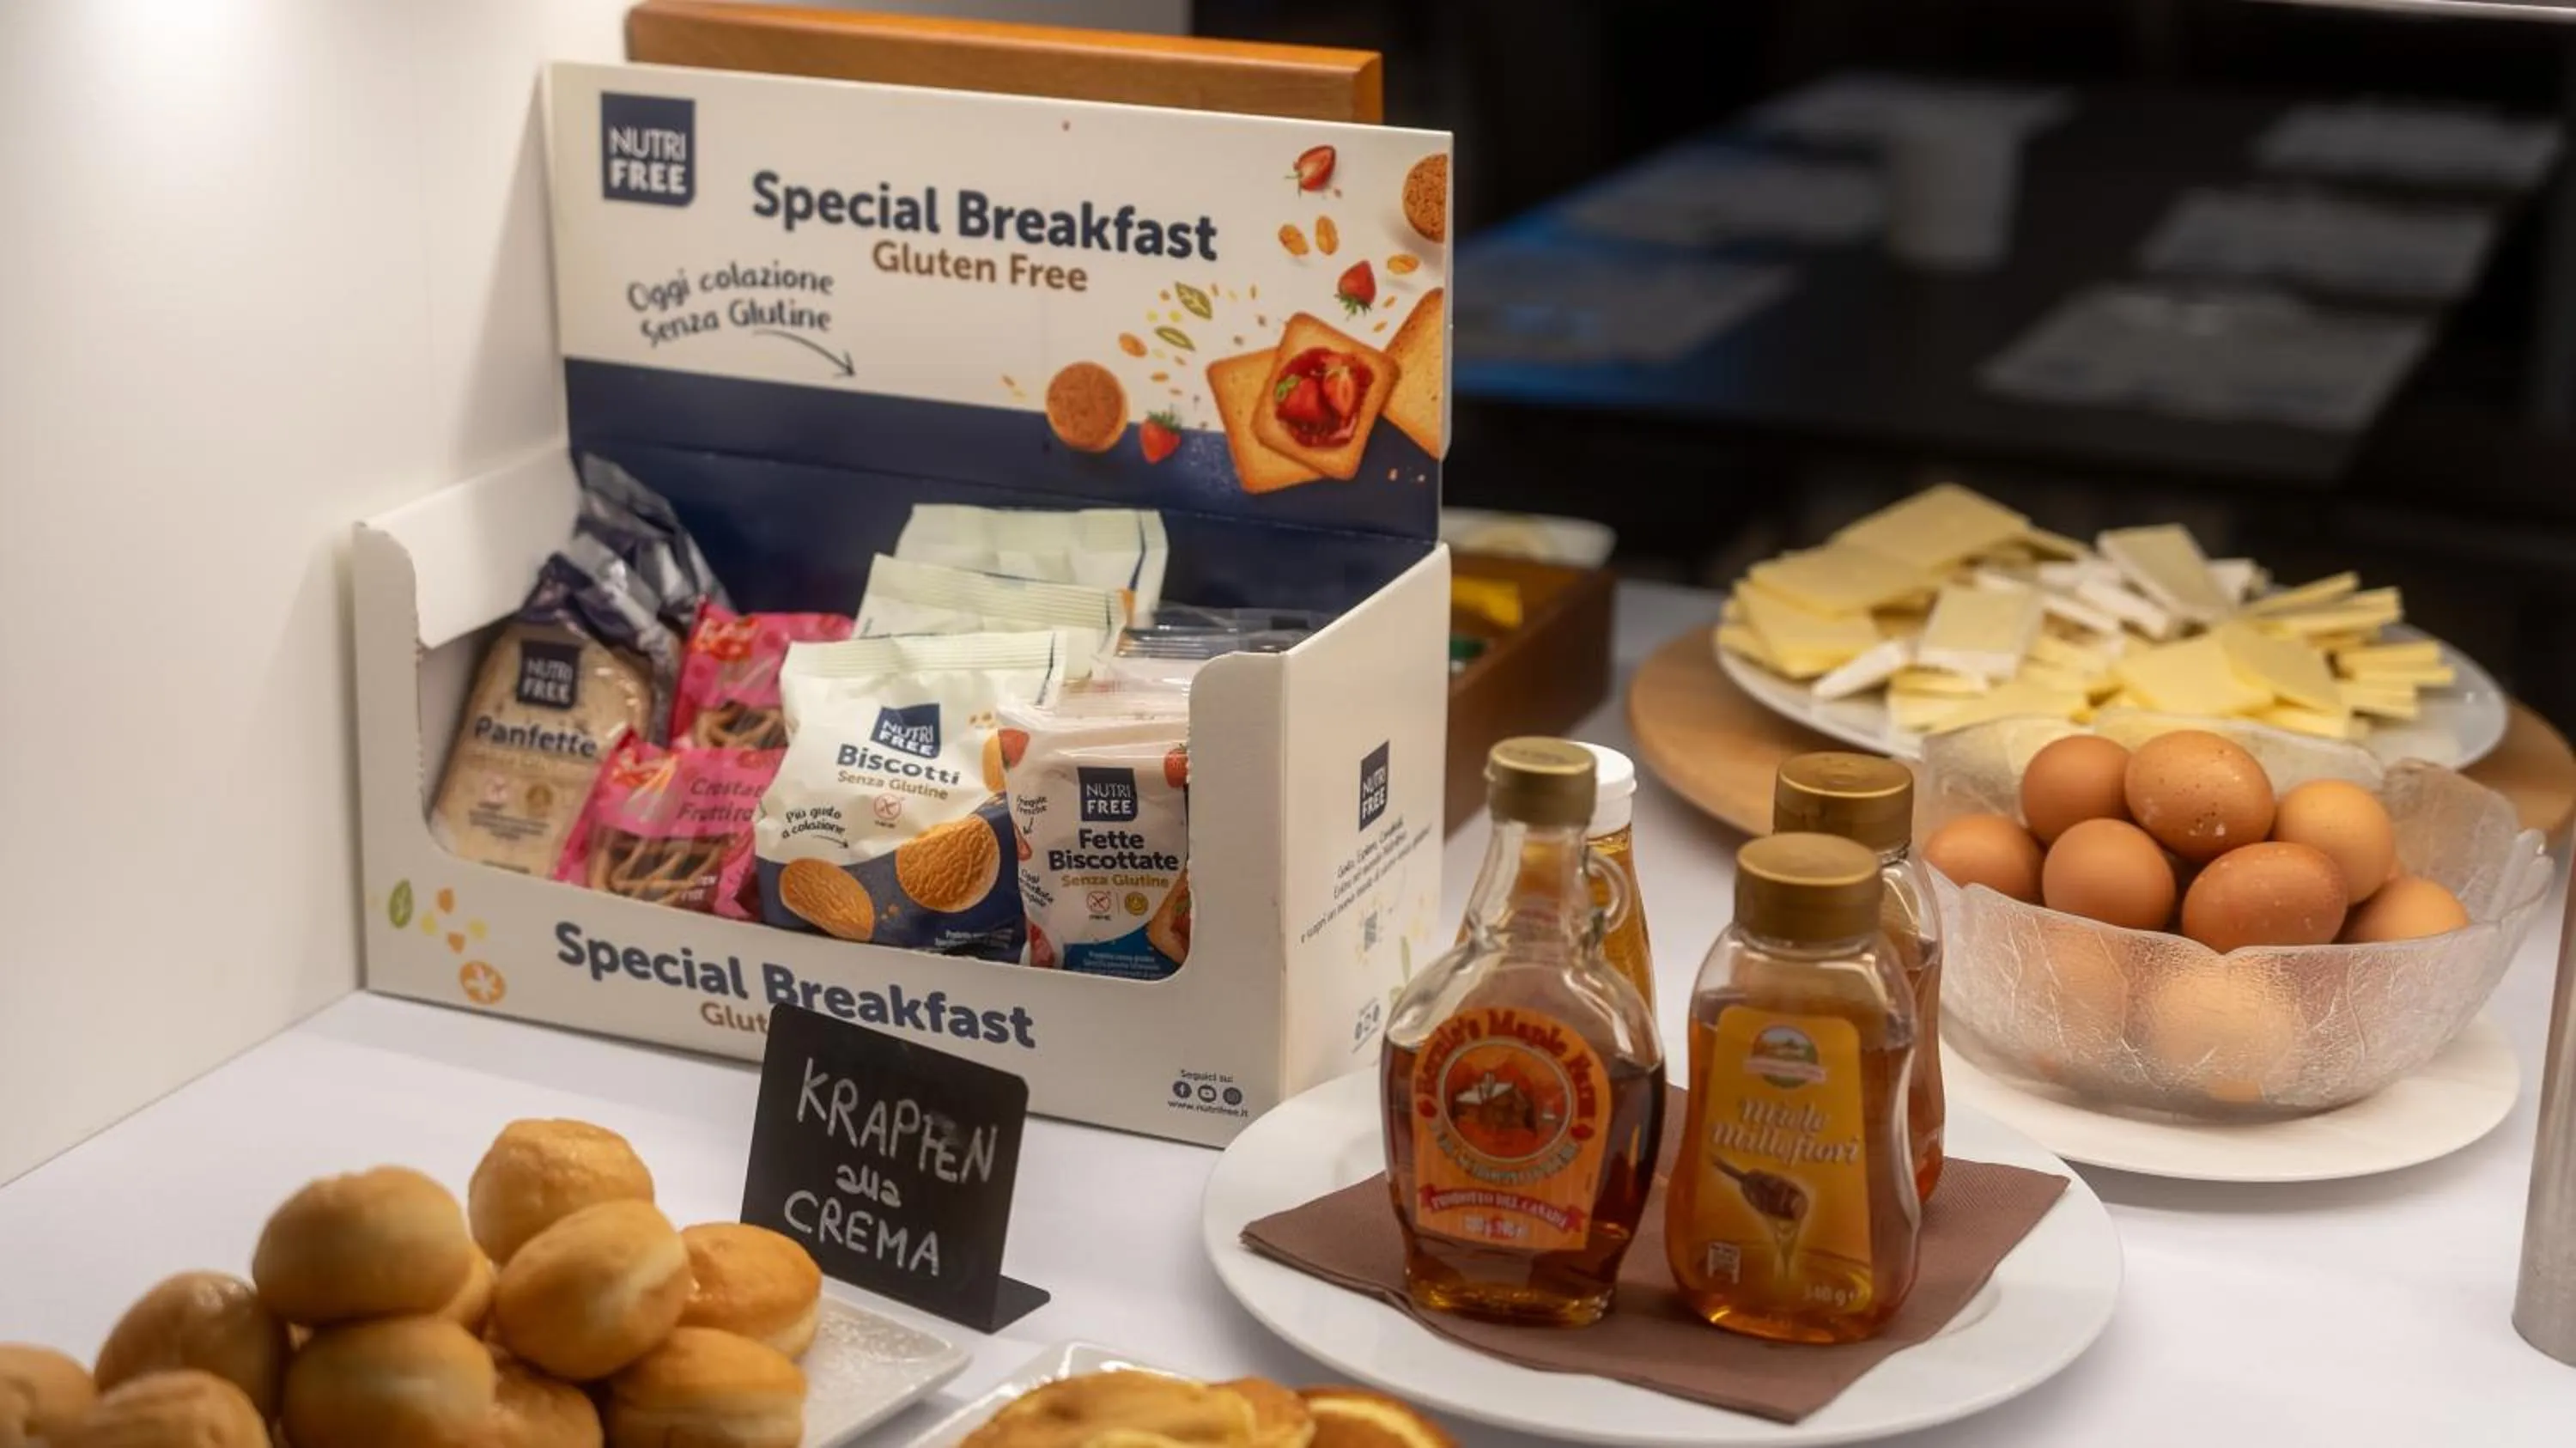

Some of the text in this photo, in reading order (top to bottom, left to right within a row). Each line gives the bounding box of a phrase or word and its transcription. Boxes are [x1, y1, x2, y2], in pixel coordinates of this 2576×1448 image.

[609, 126, 686, 161] NUTRI
[610, 159, 687, 194] FREE
[752, 168, 1218, 262] Special Breakfast
[872, 241, 1088, 294] Gluten Free
[627, 259, 835, 313] Oggi colazione
[728, 298, 832, 332] Glutine
[525, 655, 572, 682] NUTRI
[522, 676, 570, 704] FREE
[475, 715, 598, 759] Panfette
[878, 731, 934, 757] FREE
[881, 719, 936, 744] NUTRI
[836, 743, 961, 786] Biscotti
[837, 770, 950, 800] Senza Glutine
[1085, 782, 1131, 799] NUTRI
[1362, 765, 1386, 797] NUTRI
[1086, 799, 1133, 816] FREE
[1361, 788, 1387, 821] FREE
[1078, 829, 1145, 850] Fette
[1048, 849, 1180, 871] Biscottate
[1061, 873, 1170, 889] Senza Glutine
[555, 921, 1036, 1049] Special Breakfast
[701, 1001, 770, 1033] Glut
[1487, 1009, 1567, 1057] Maple
[782, 1189, 940, 1277] CREMA
